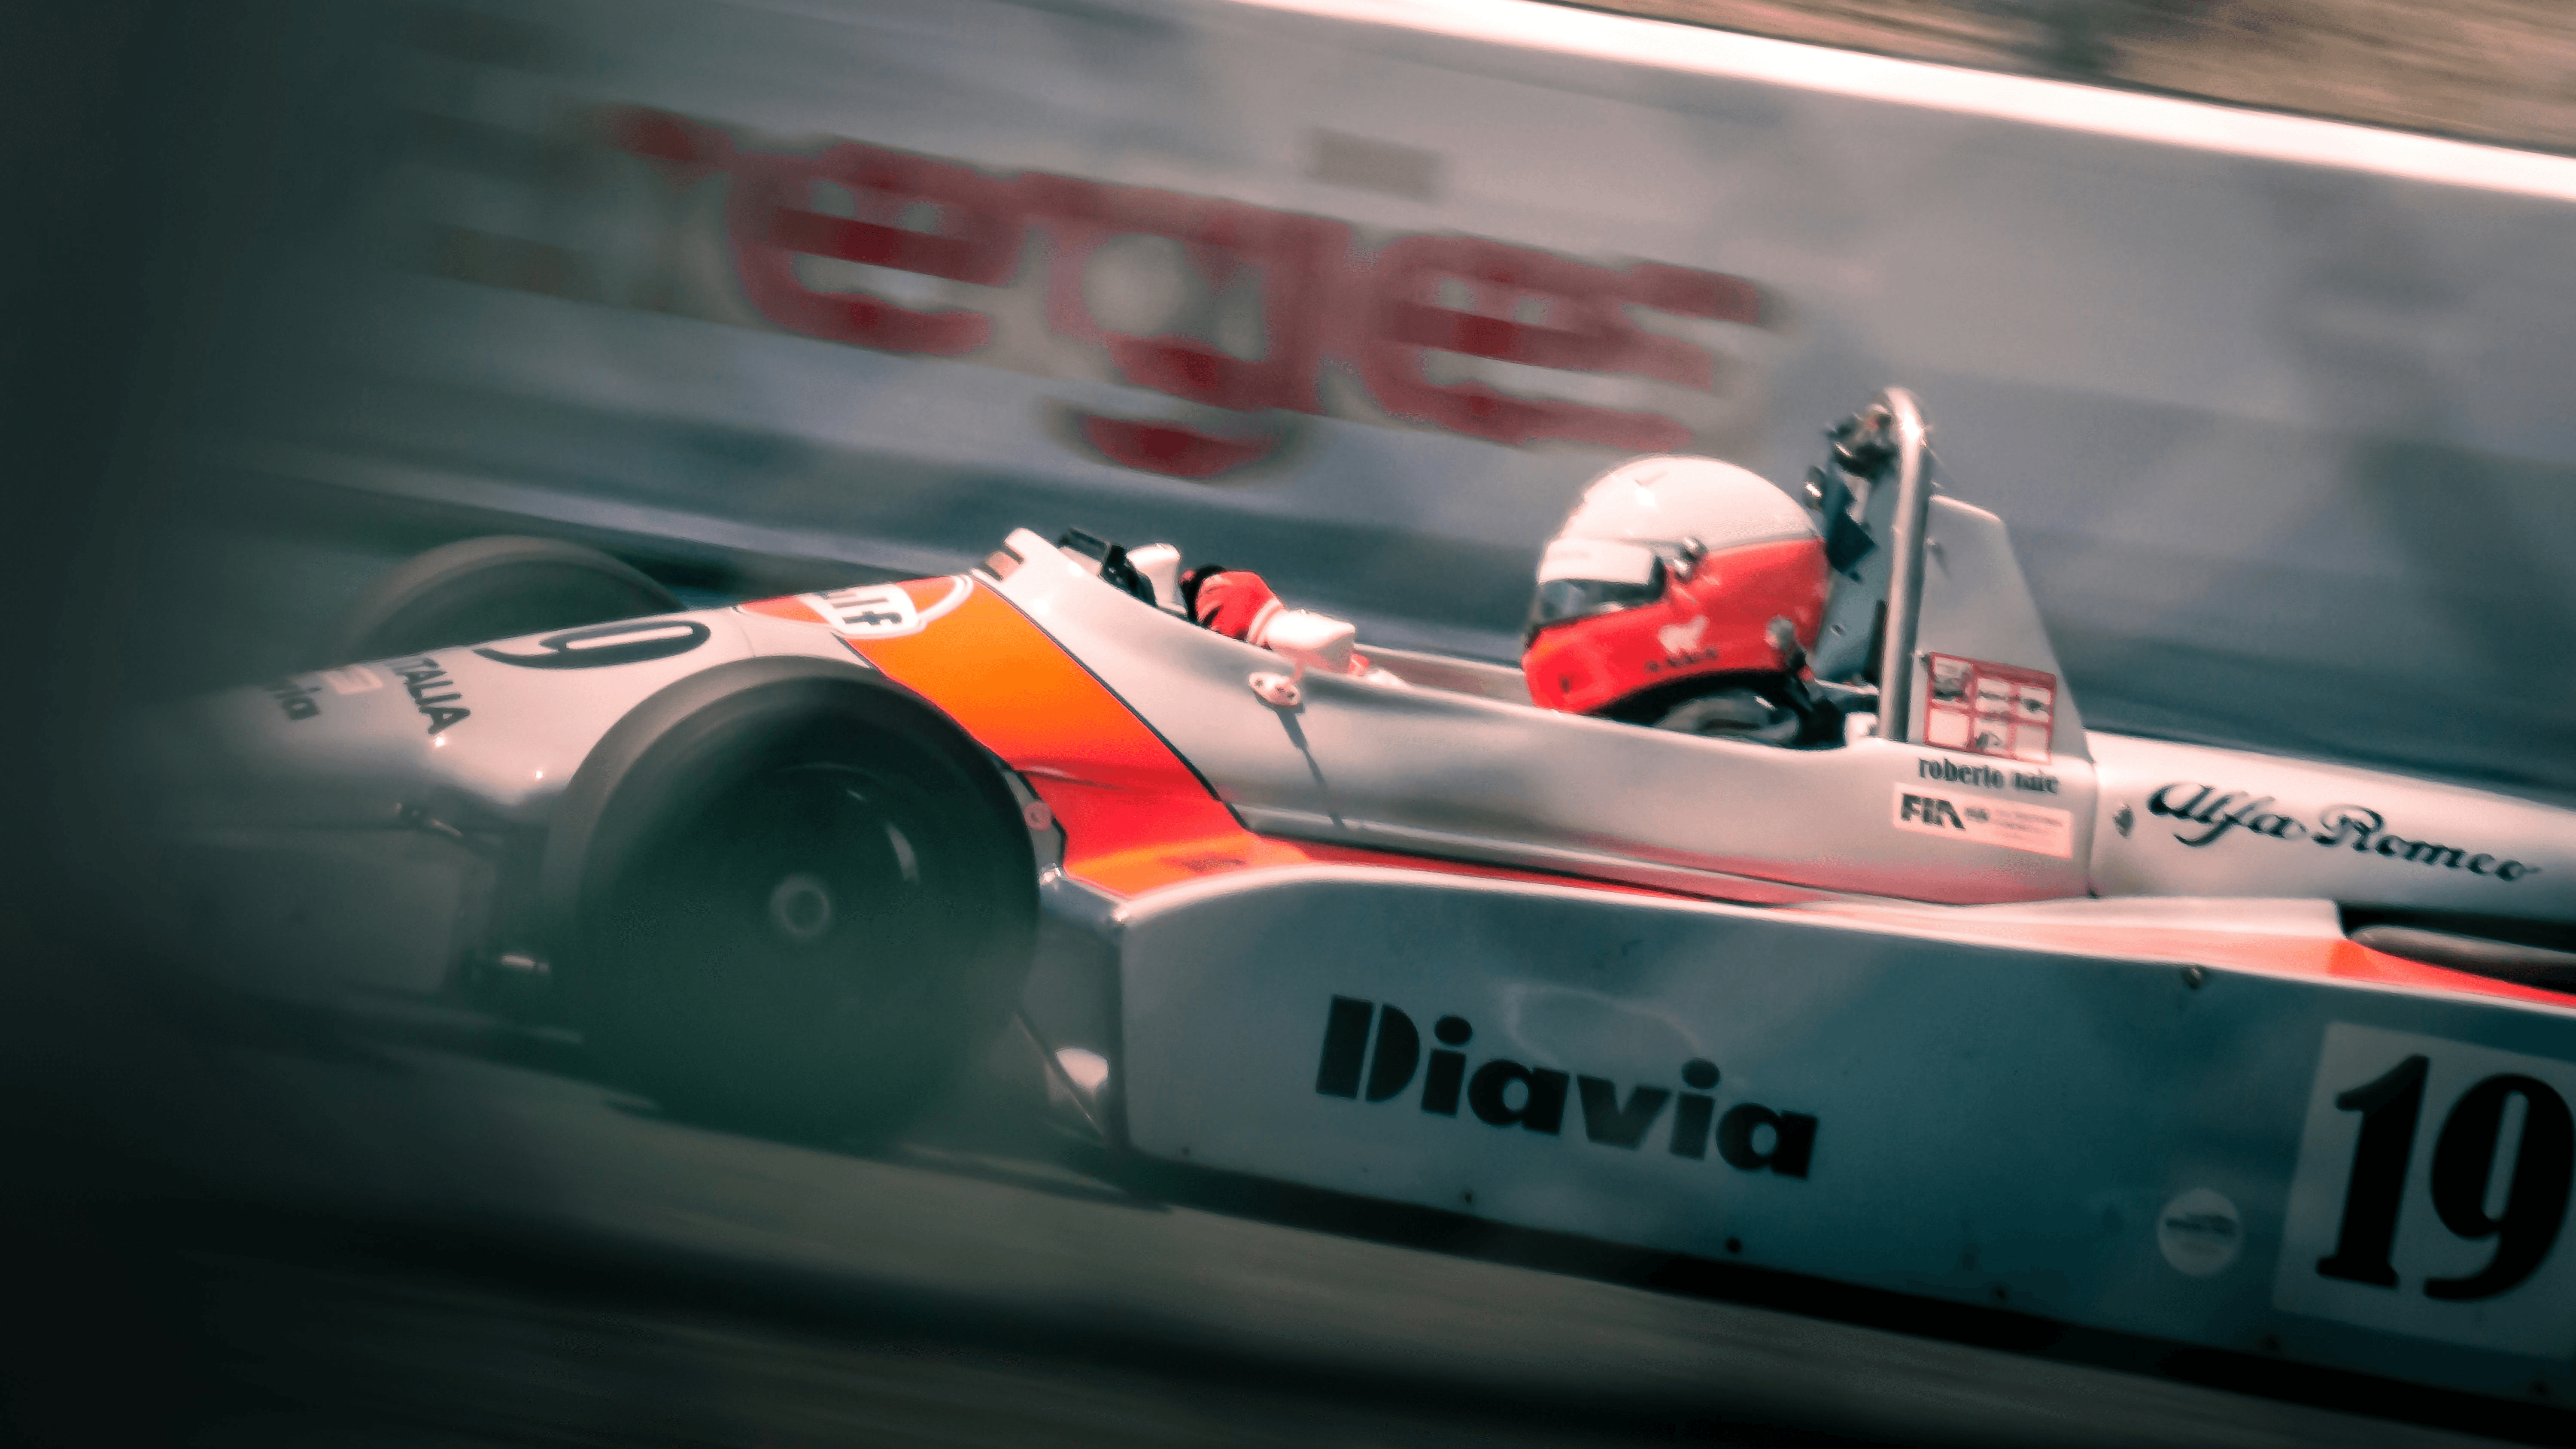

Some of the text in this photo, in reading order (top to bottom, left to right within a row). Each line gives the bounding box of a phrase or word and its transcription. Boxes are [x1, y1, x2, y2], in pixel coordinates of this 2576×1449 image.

[1900, 793, 1966, 831] FIA
[2147, 781, 2307, 848] Alfa
[2312, 804, 2542, 882] Romeo
[1315, 993, 1818, 1181] Diavia
[2315, 1053, 2576, 1302] 19
